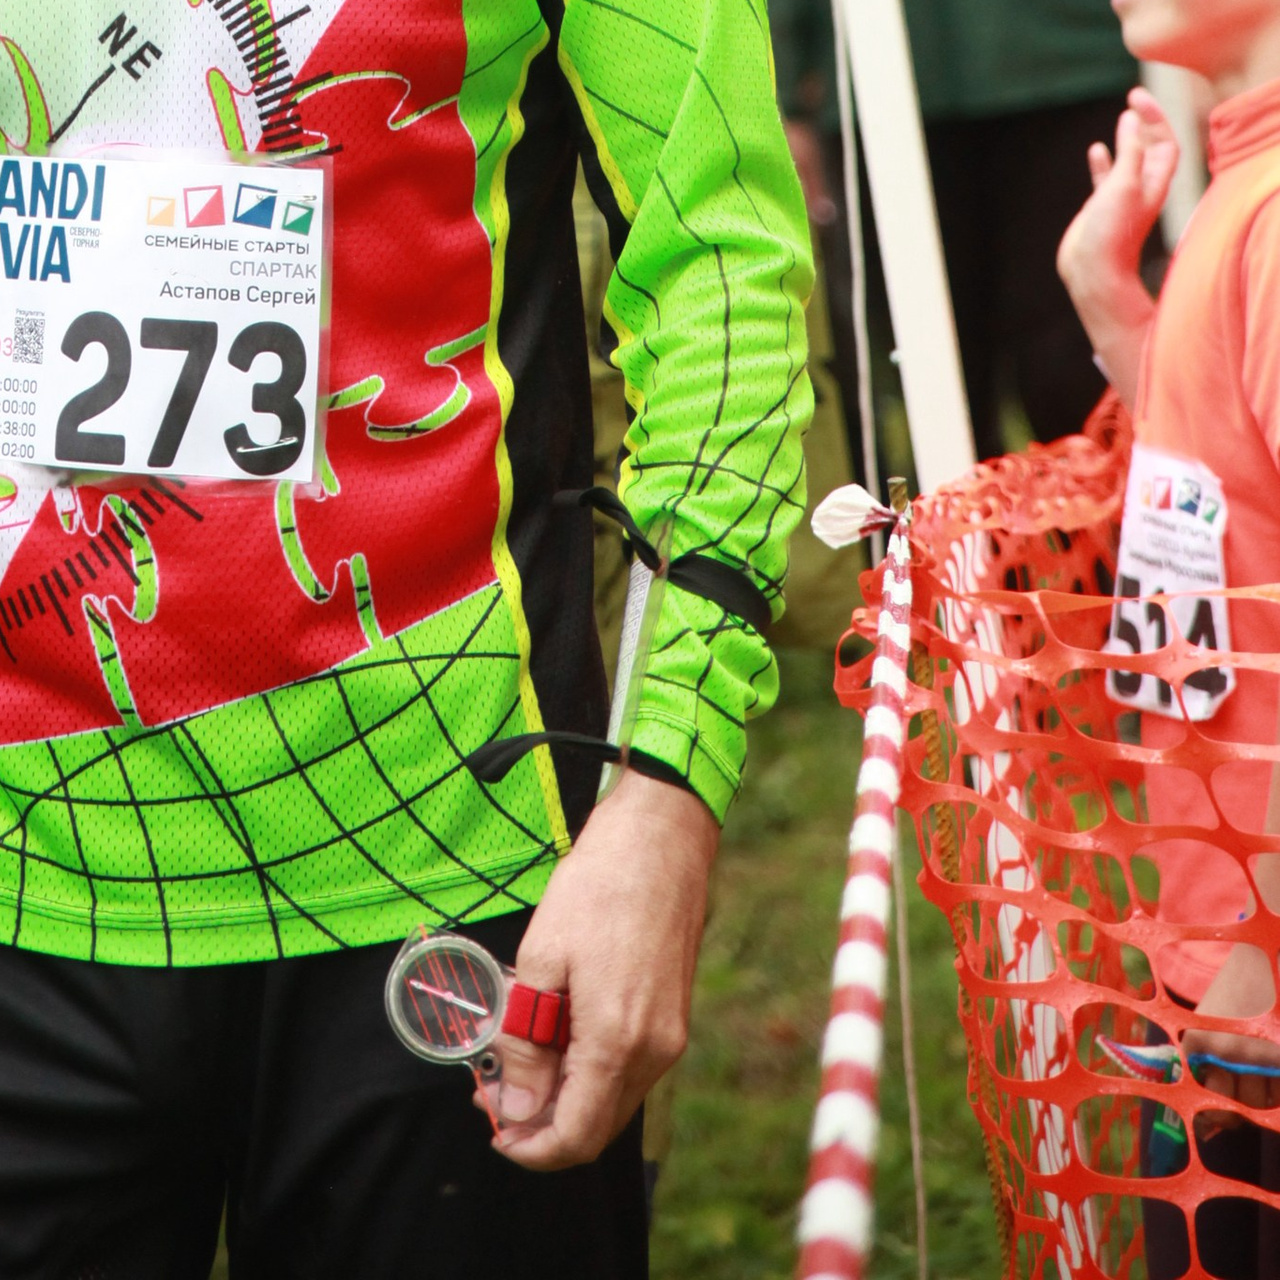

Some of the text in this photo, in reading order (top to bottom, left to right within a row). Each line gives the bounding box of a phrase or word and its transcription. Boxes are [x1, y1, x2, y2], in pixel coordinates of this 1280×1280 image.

[98, 11, 163, 82] NE
[144, 234, 309, 255] СЕМЕЙНЫЕ СТАРТЫ
[230, 260, 317, 279] СПАРТАК
[160, 281, 316, 308] Астапов Сергей
[54, 310, 308, 476] 273
